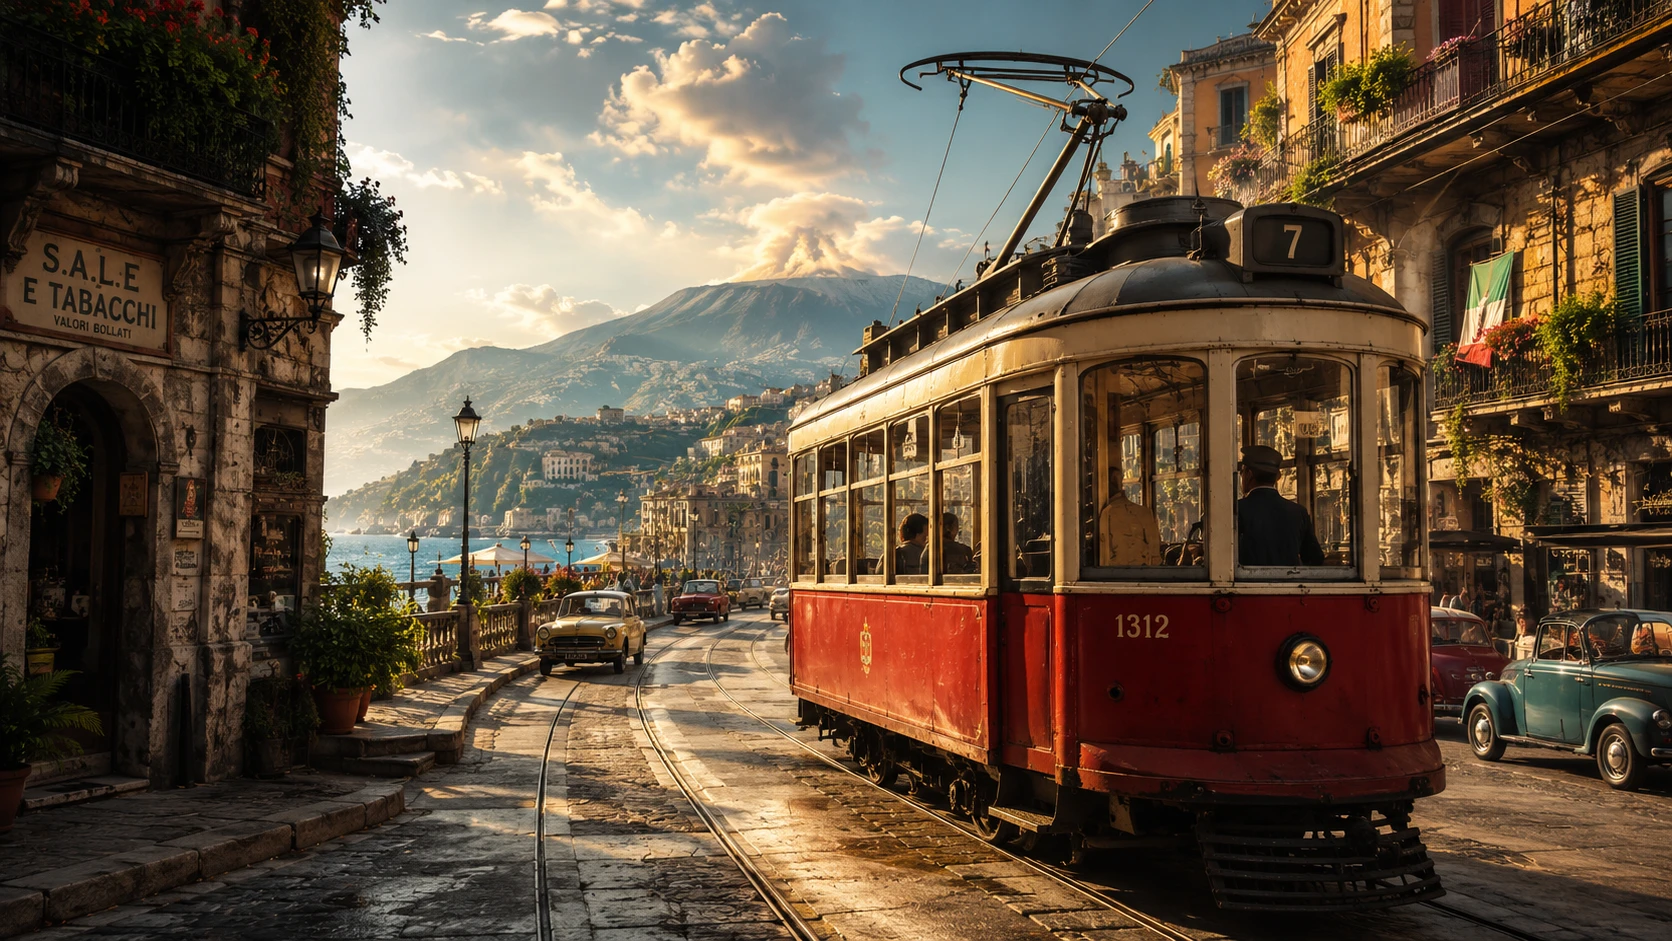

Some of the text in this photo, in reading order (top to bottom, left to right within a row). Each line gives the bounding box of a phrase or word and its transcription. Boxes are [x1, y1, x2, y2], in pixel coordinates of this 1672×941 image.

[1283, 224, 1303, 259] 7
[42, 243, 140, 293] S.A.L.E
[23, 276, 157, 330] E TABACCHI
[53, 314, 132, 339] VALORI BOLLATI
[1115, 613, 1169, 639] 1312
